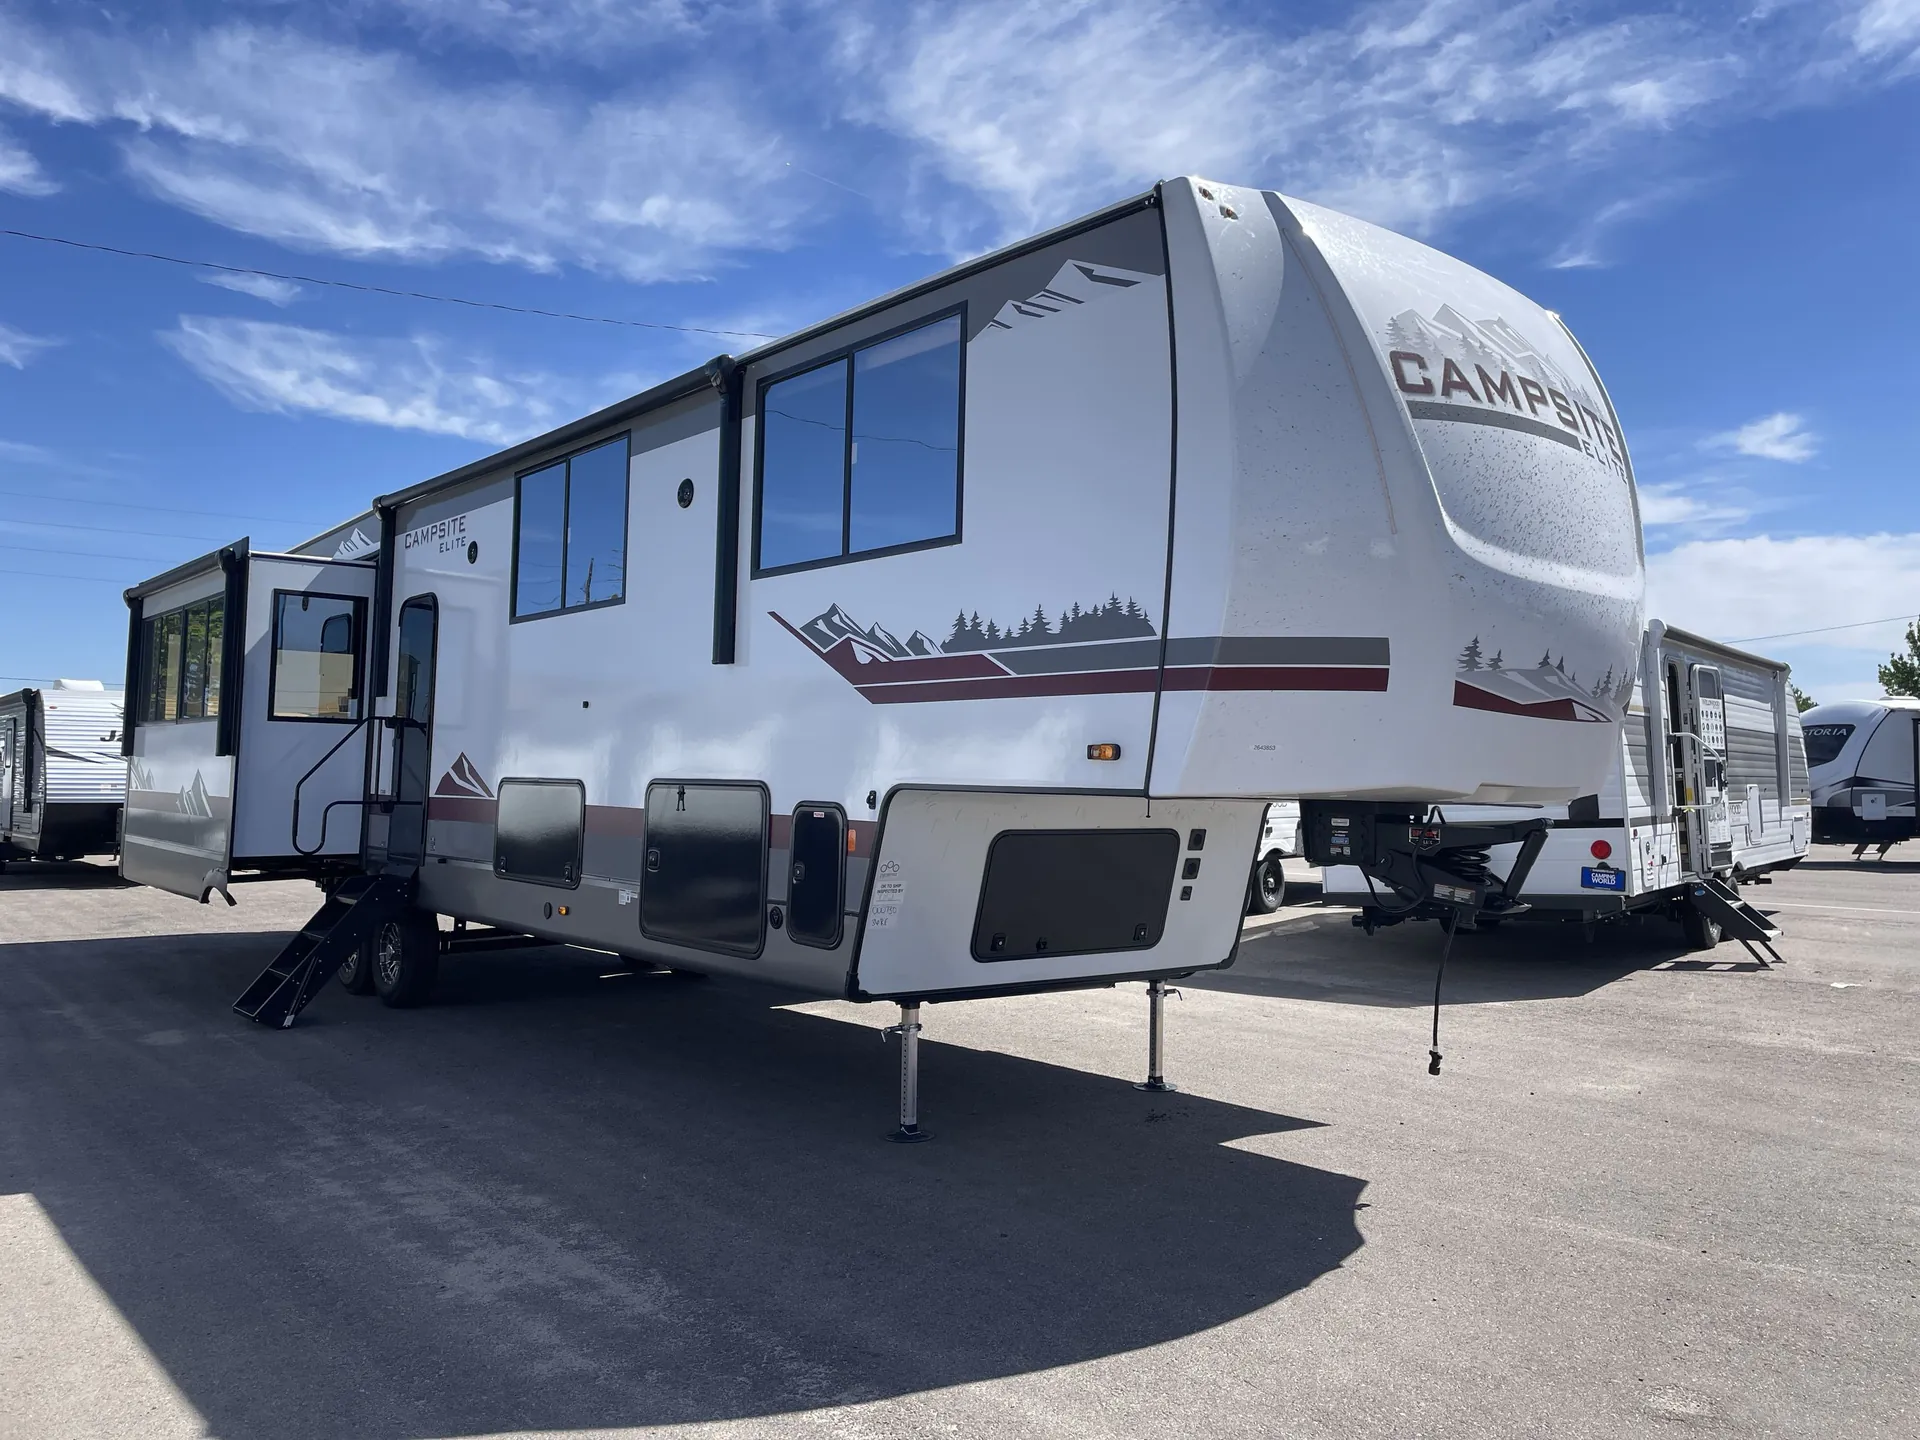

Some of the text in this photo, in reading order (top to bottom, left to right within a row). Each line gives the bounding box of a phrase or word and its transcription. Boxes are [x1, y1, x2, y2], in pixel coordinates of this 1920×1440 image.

[1389, 350, 1623, 466] CAMPSITE
[1581, 439, 1627, 485] ELITE
[404, 515, 466, 549] CAMPSITE
[439, 536, 466, 553] ELITE
[1591, 872, 1616, 880] CAMPING
[1591, 877, 1616, 885] WORLD
